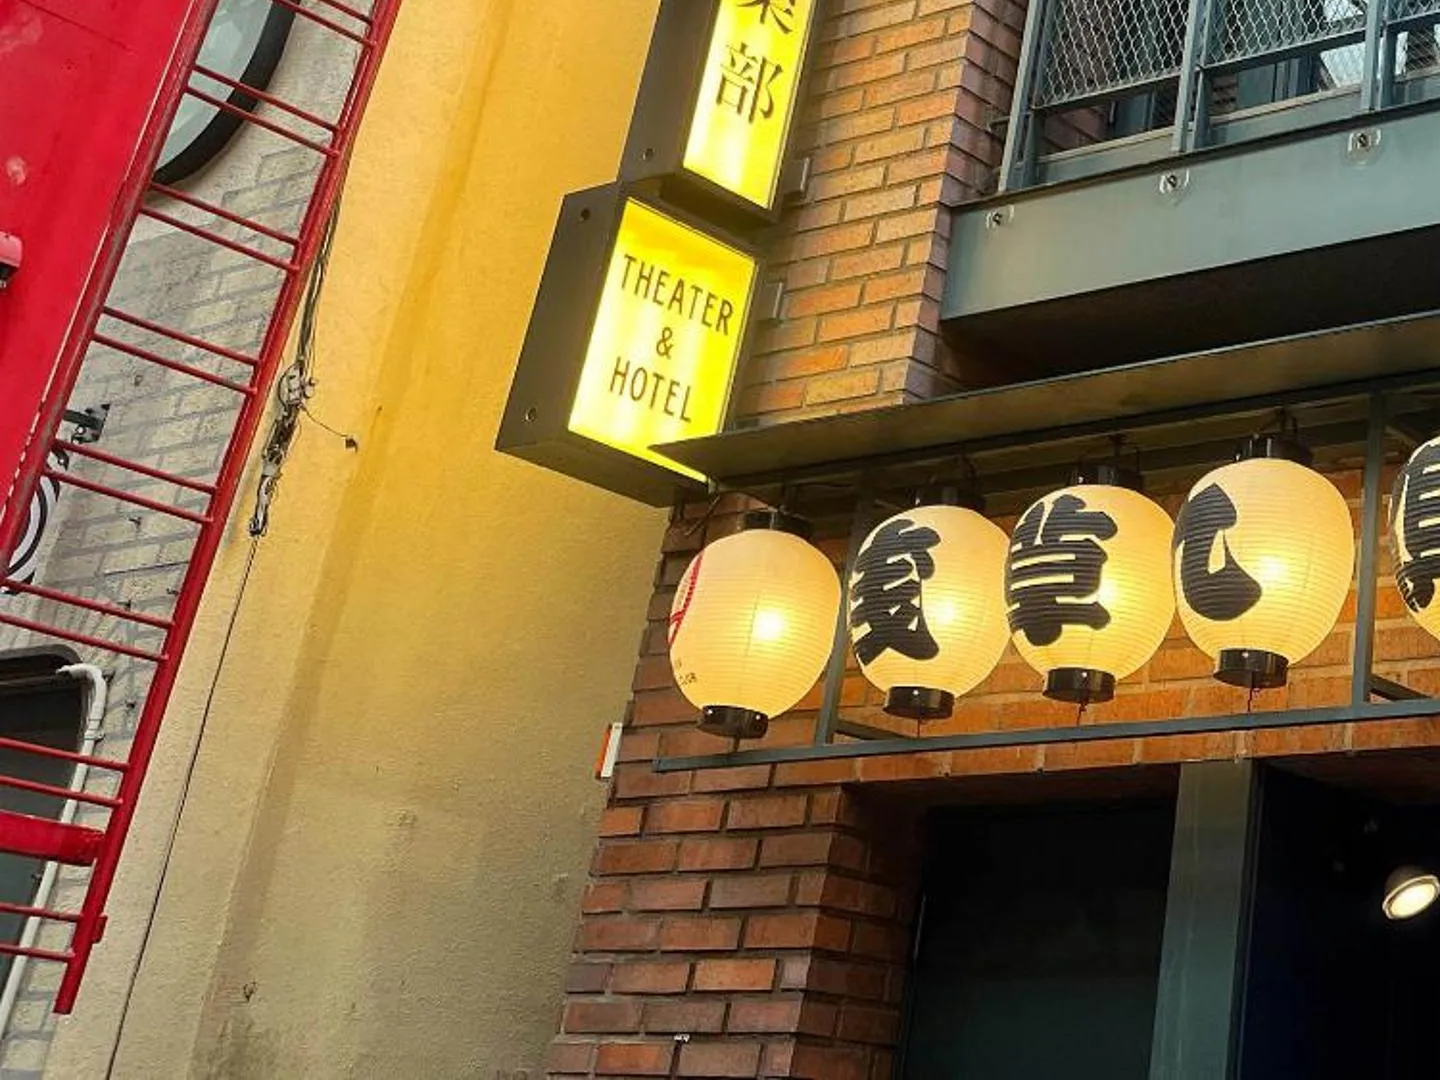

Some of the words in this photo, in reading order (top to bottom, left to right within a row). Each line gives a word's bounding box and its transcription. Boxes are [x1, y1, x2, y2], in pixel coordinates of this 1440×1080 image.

[621, 253, 734, 336] THEATER
[655, 326, 675, 360] &
[609, 356, 692, 423] HOTEL
